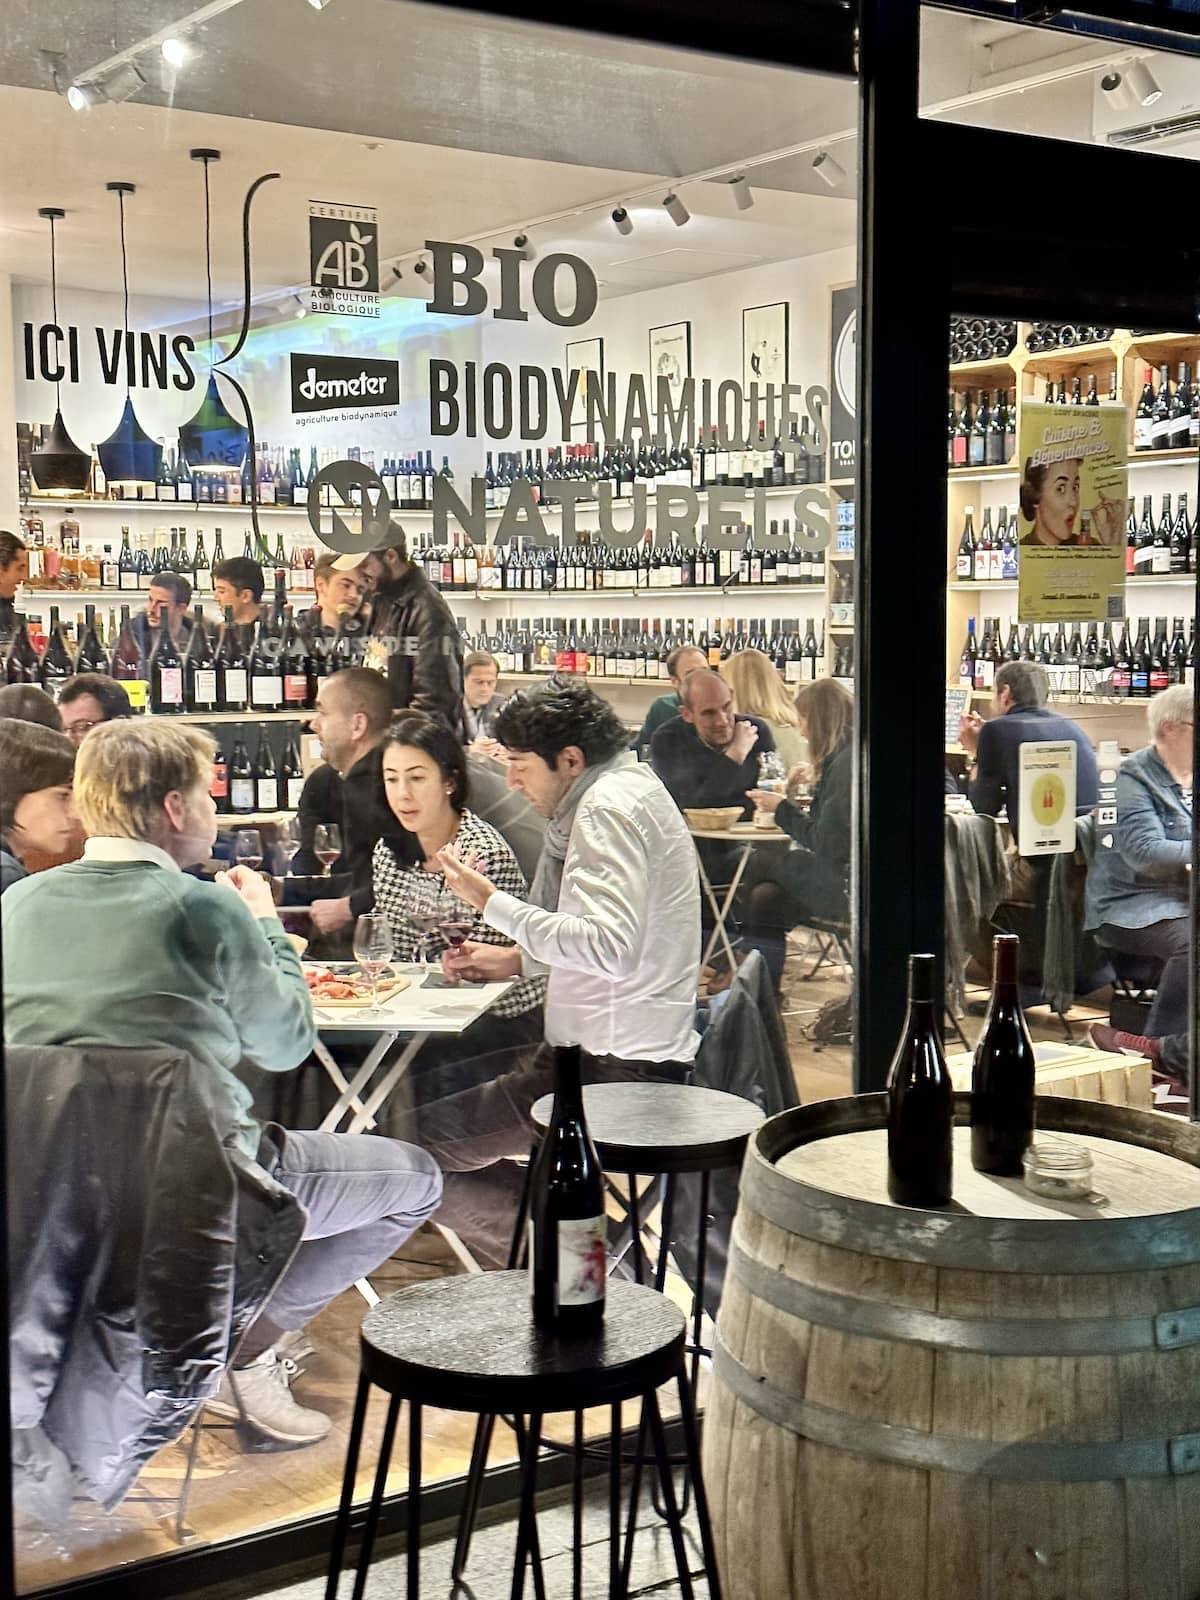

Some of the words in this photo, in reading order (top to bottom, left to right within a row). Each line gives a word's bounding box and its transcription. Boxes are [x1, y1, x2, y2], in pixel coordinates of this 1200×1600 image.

[314, 240, 370, 288] AB
[424, 240, 599, 327] BIO
[311, 302, 381, 315] BIOLOGIQUE
[24, 322, 79, 384] ICI
[95, 327, 196, 392] VINS
[299, 367, 388, 400] demeter
[295, 415, 339, 427] agriculture
[341, 409, 398, 421] biodynamique
[429, 358, 829, 457] BIODYNAMIQUES
[432, 476, 832, 553] NATURELS
